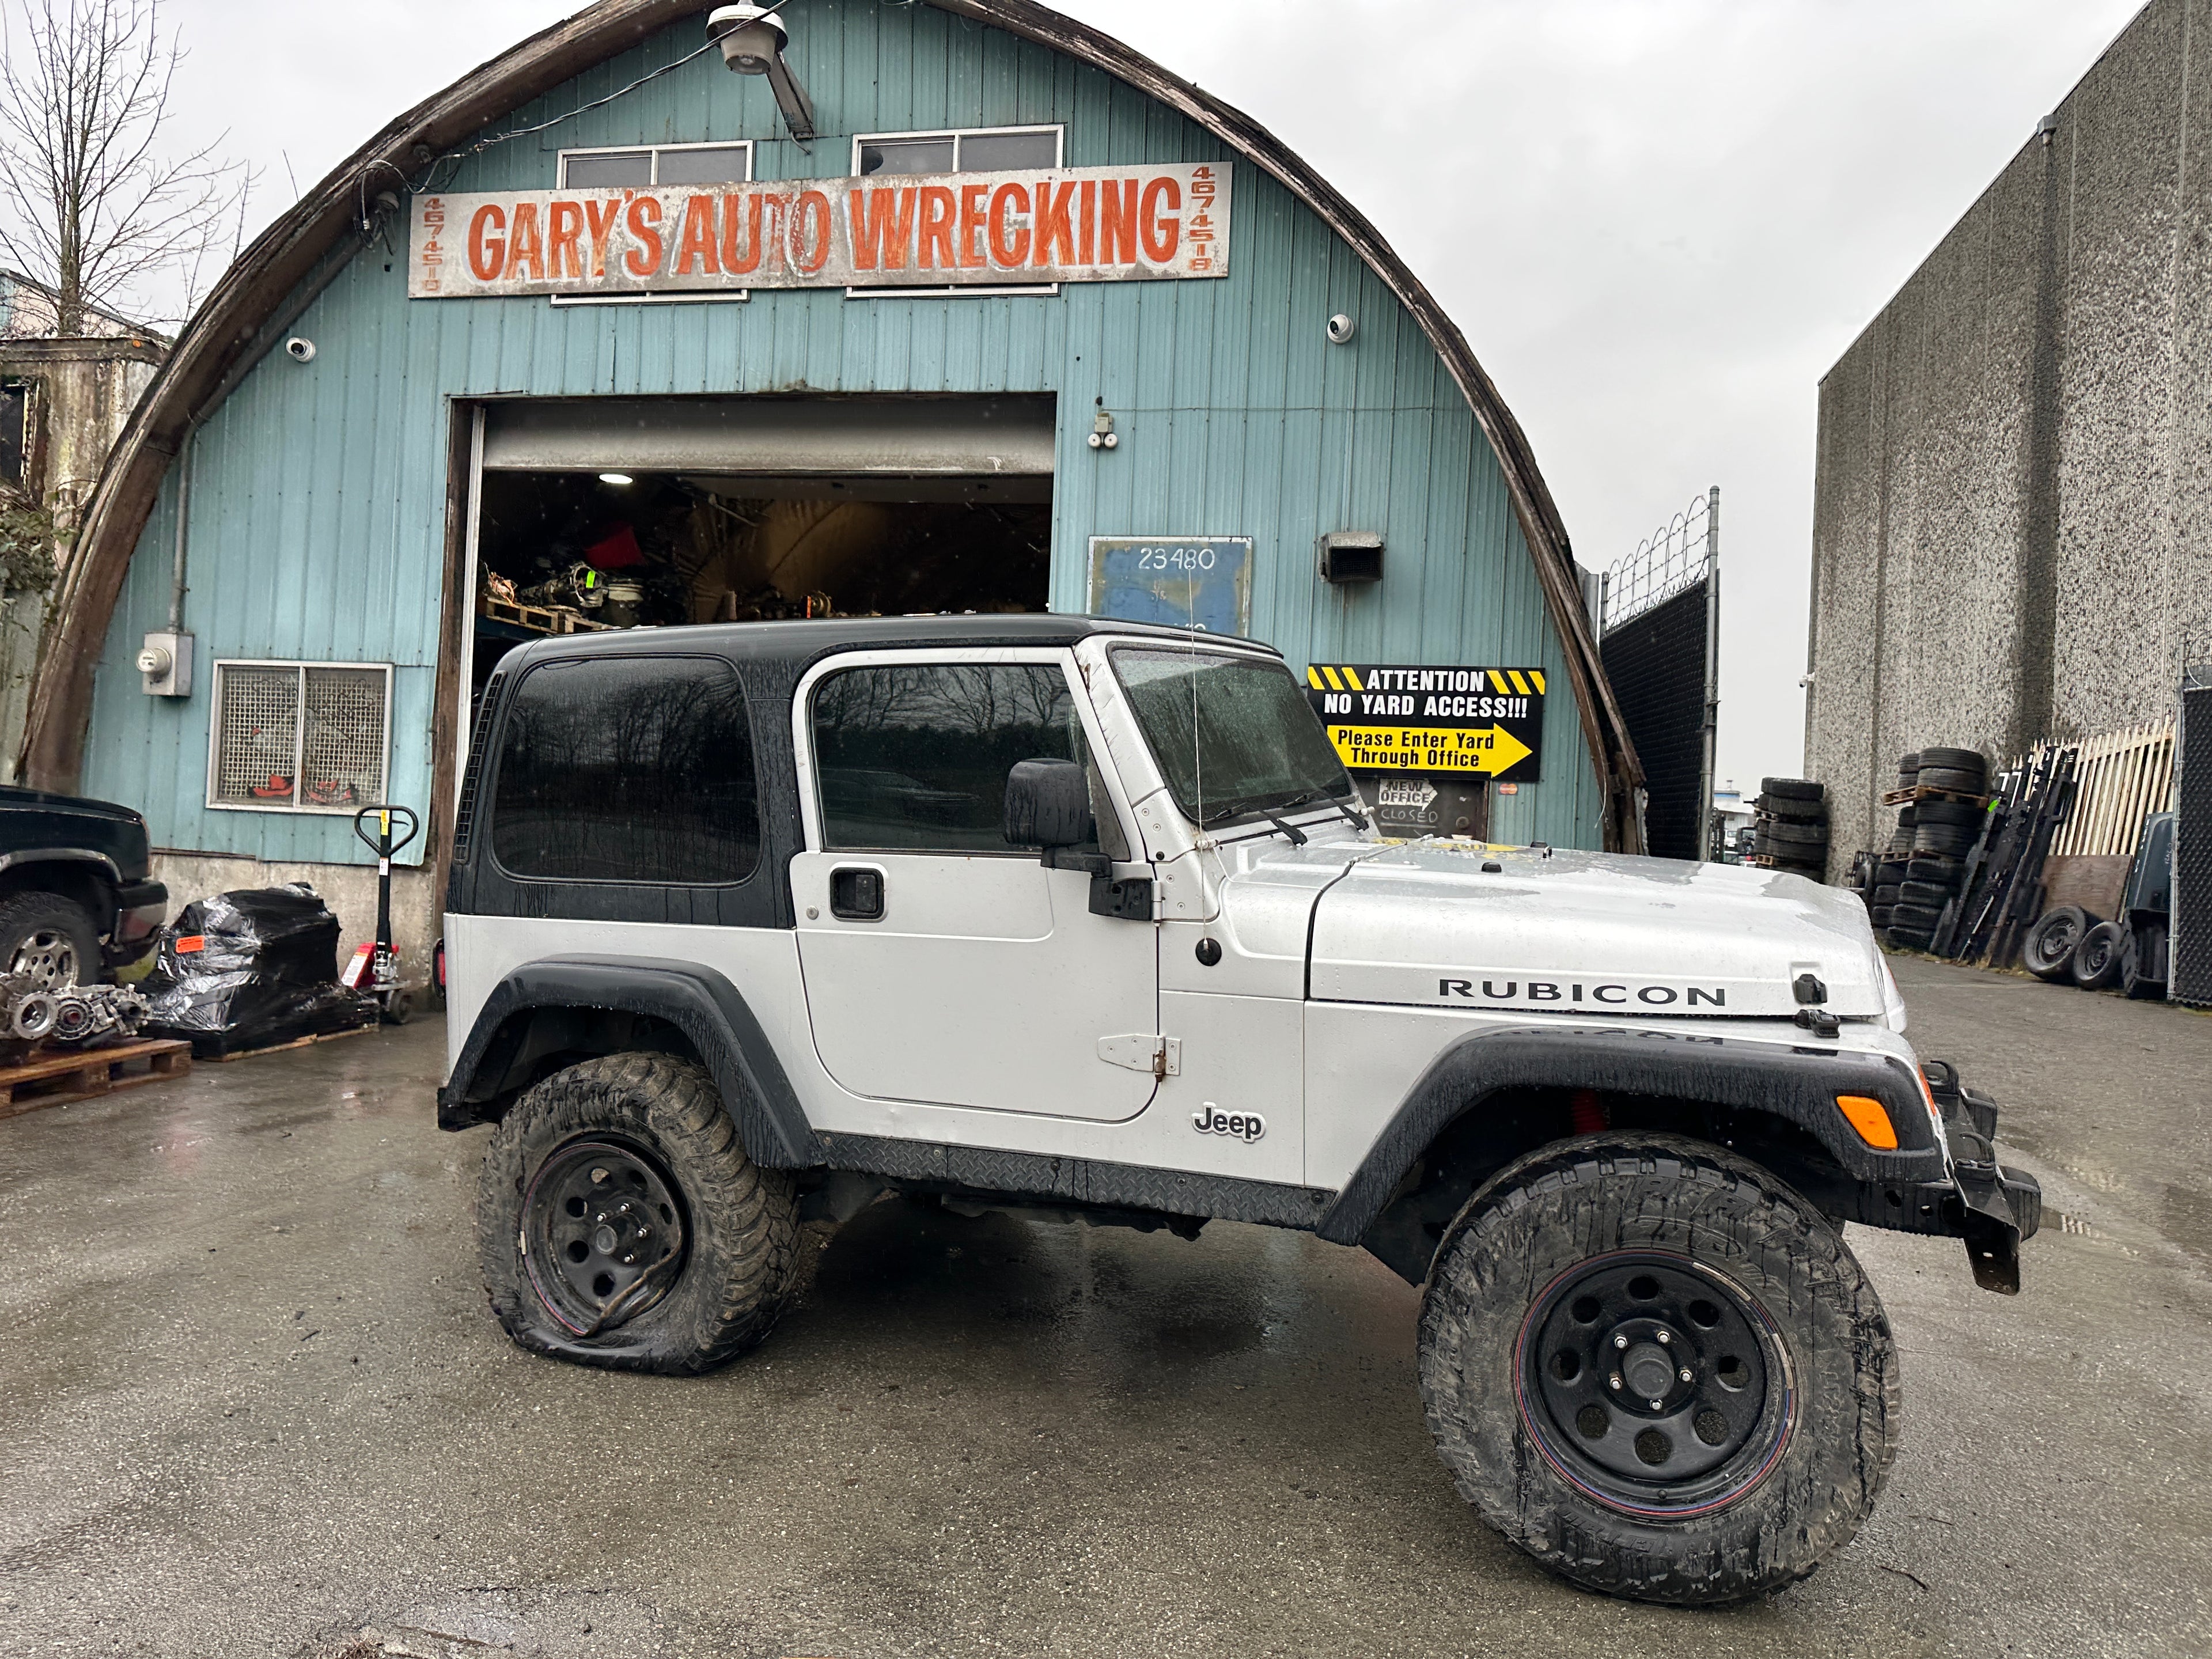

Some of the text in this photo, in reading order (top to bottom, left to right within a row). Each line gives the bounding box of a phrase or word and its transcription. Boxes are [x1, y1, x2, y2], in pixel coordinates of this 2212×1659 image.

[468, 177, 1181, 281] GARY'S AUTO WRECKING
[1138, 548, 1215, 570] 23480
[1366, 669, 1484, 692] ATTENTION
[1324, 694, 1528, 718] NO YARD ACCESS!!!
[1338, 729, 1494, 749] Please Enter Yard
[1351, 748, 1479, 767] Through Office
[1381, 791, 1430, 802] OFFICE
[1388, 781, 1422, 791] NEW
[1381, 809, 1438, 823] CLOSED
[1440, 979, 1725, 1006] RUBICON
[1194, 1107, 1262, 1139] Jeep
